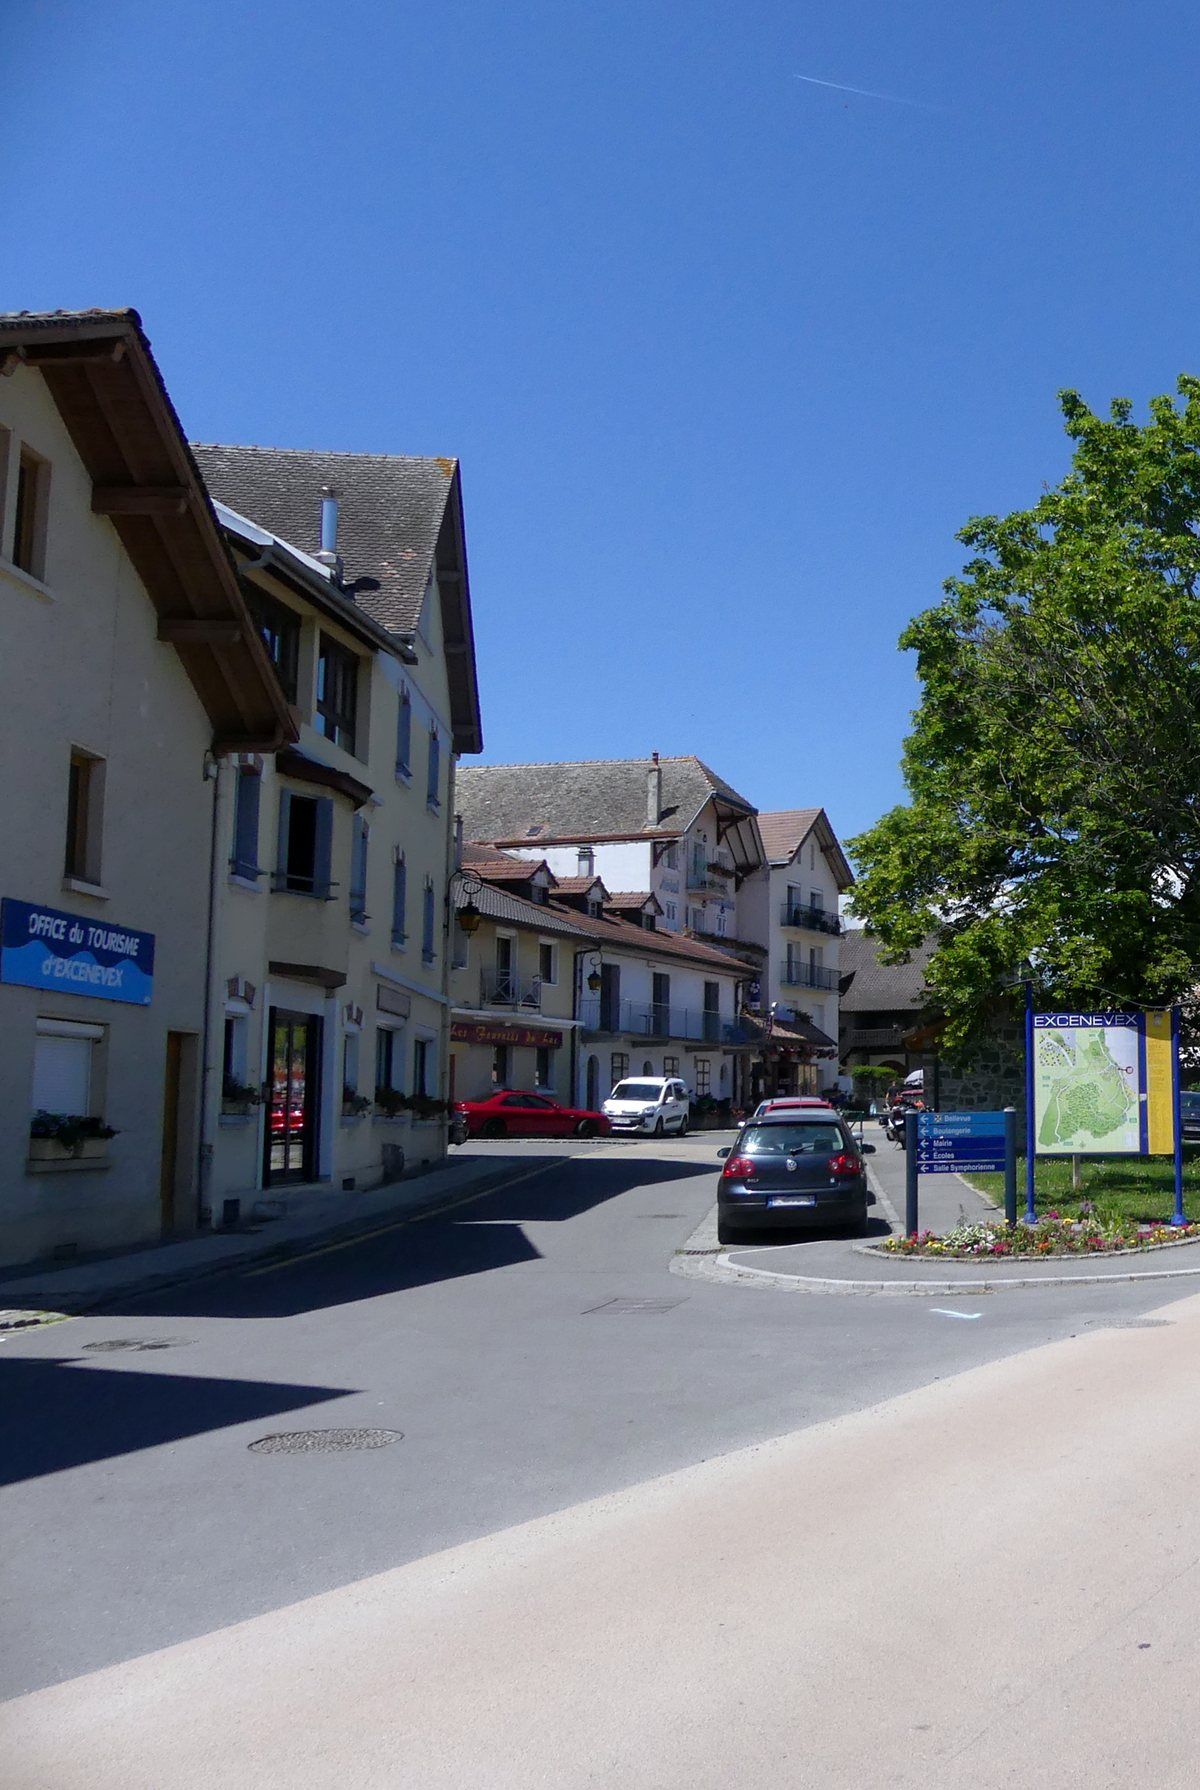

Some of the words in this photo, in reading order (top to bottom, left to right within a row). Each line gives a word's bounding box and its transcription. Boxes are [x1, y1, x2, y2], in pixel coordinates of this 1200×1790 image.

[28, 912, 68, 941] OFFICE
[69, 922, 84, 944] du
[88, 927, 140, 957] TOURISME
[41, 954, 124, 987] d'EXCENEVEX
[1034, 1014, 1138, 1027] EXCENEVEX
[944, 1114, 971, 1122] Bellevue
[933, 1127, 971, 1136] Boulangerie
[933, 1151, 955, 1160] Écoles
[933, 1164, 949, 1172] Salle
[950, 1163, 995, 1172] Symphorienne
